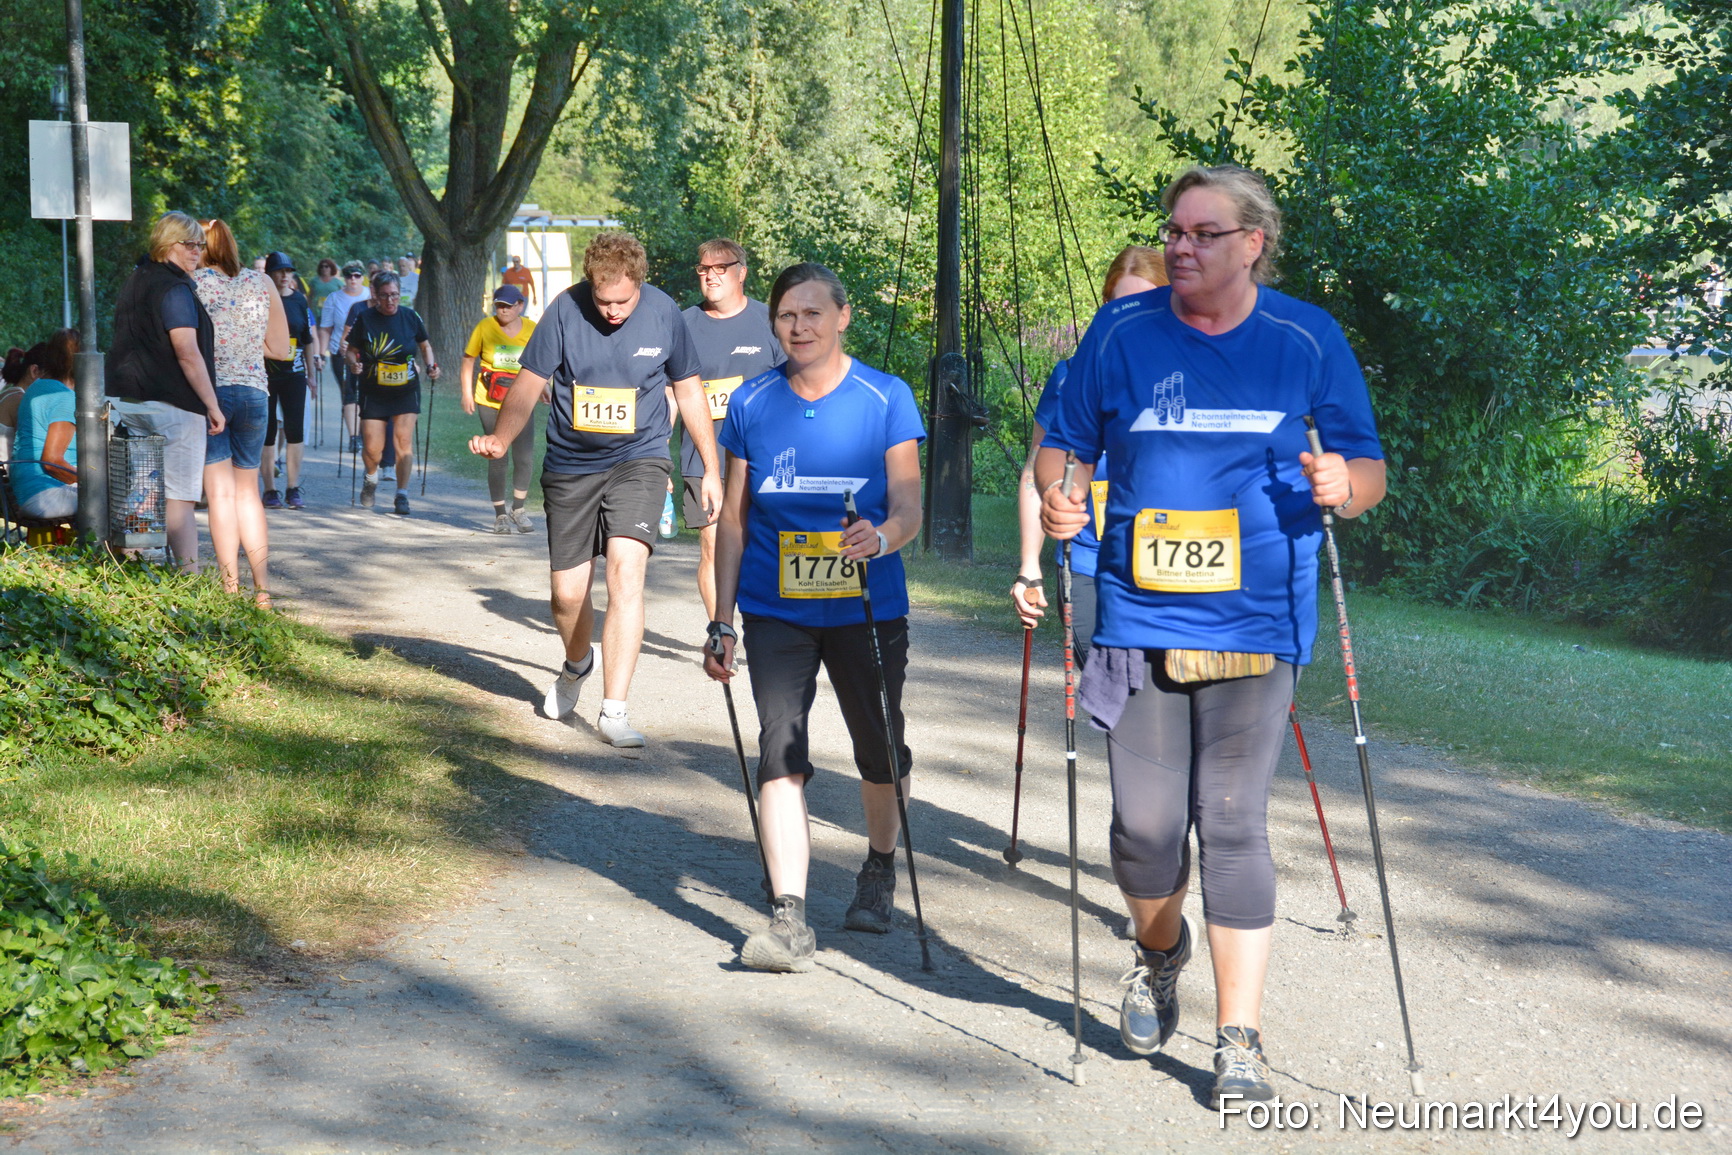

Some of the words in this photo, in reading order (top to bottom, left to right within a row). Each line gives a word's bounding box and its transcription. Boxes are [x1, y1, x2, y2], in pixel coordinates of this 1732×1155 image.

[1121, 300, 1141, 311] JAKO
[382, 371, 404, 380] 1431
[581, 402, 627, 421] 1115
[1191, 411, 1269, 422] Schornsteintechnik
[1191, 420, 1232, 429] Neumarkt
[799, 478, 854, 486] Schornsteintechnik
[1147, 538, 1225, 569] 1782
[789, 555, 856, 580] 1778
[1157, 569, 1182, 577] Bittner
[815, 579, 848, 587] Elisabeth
